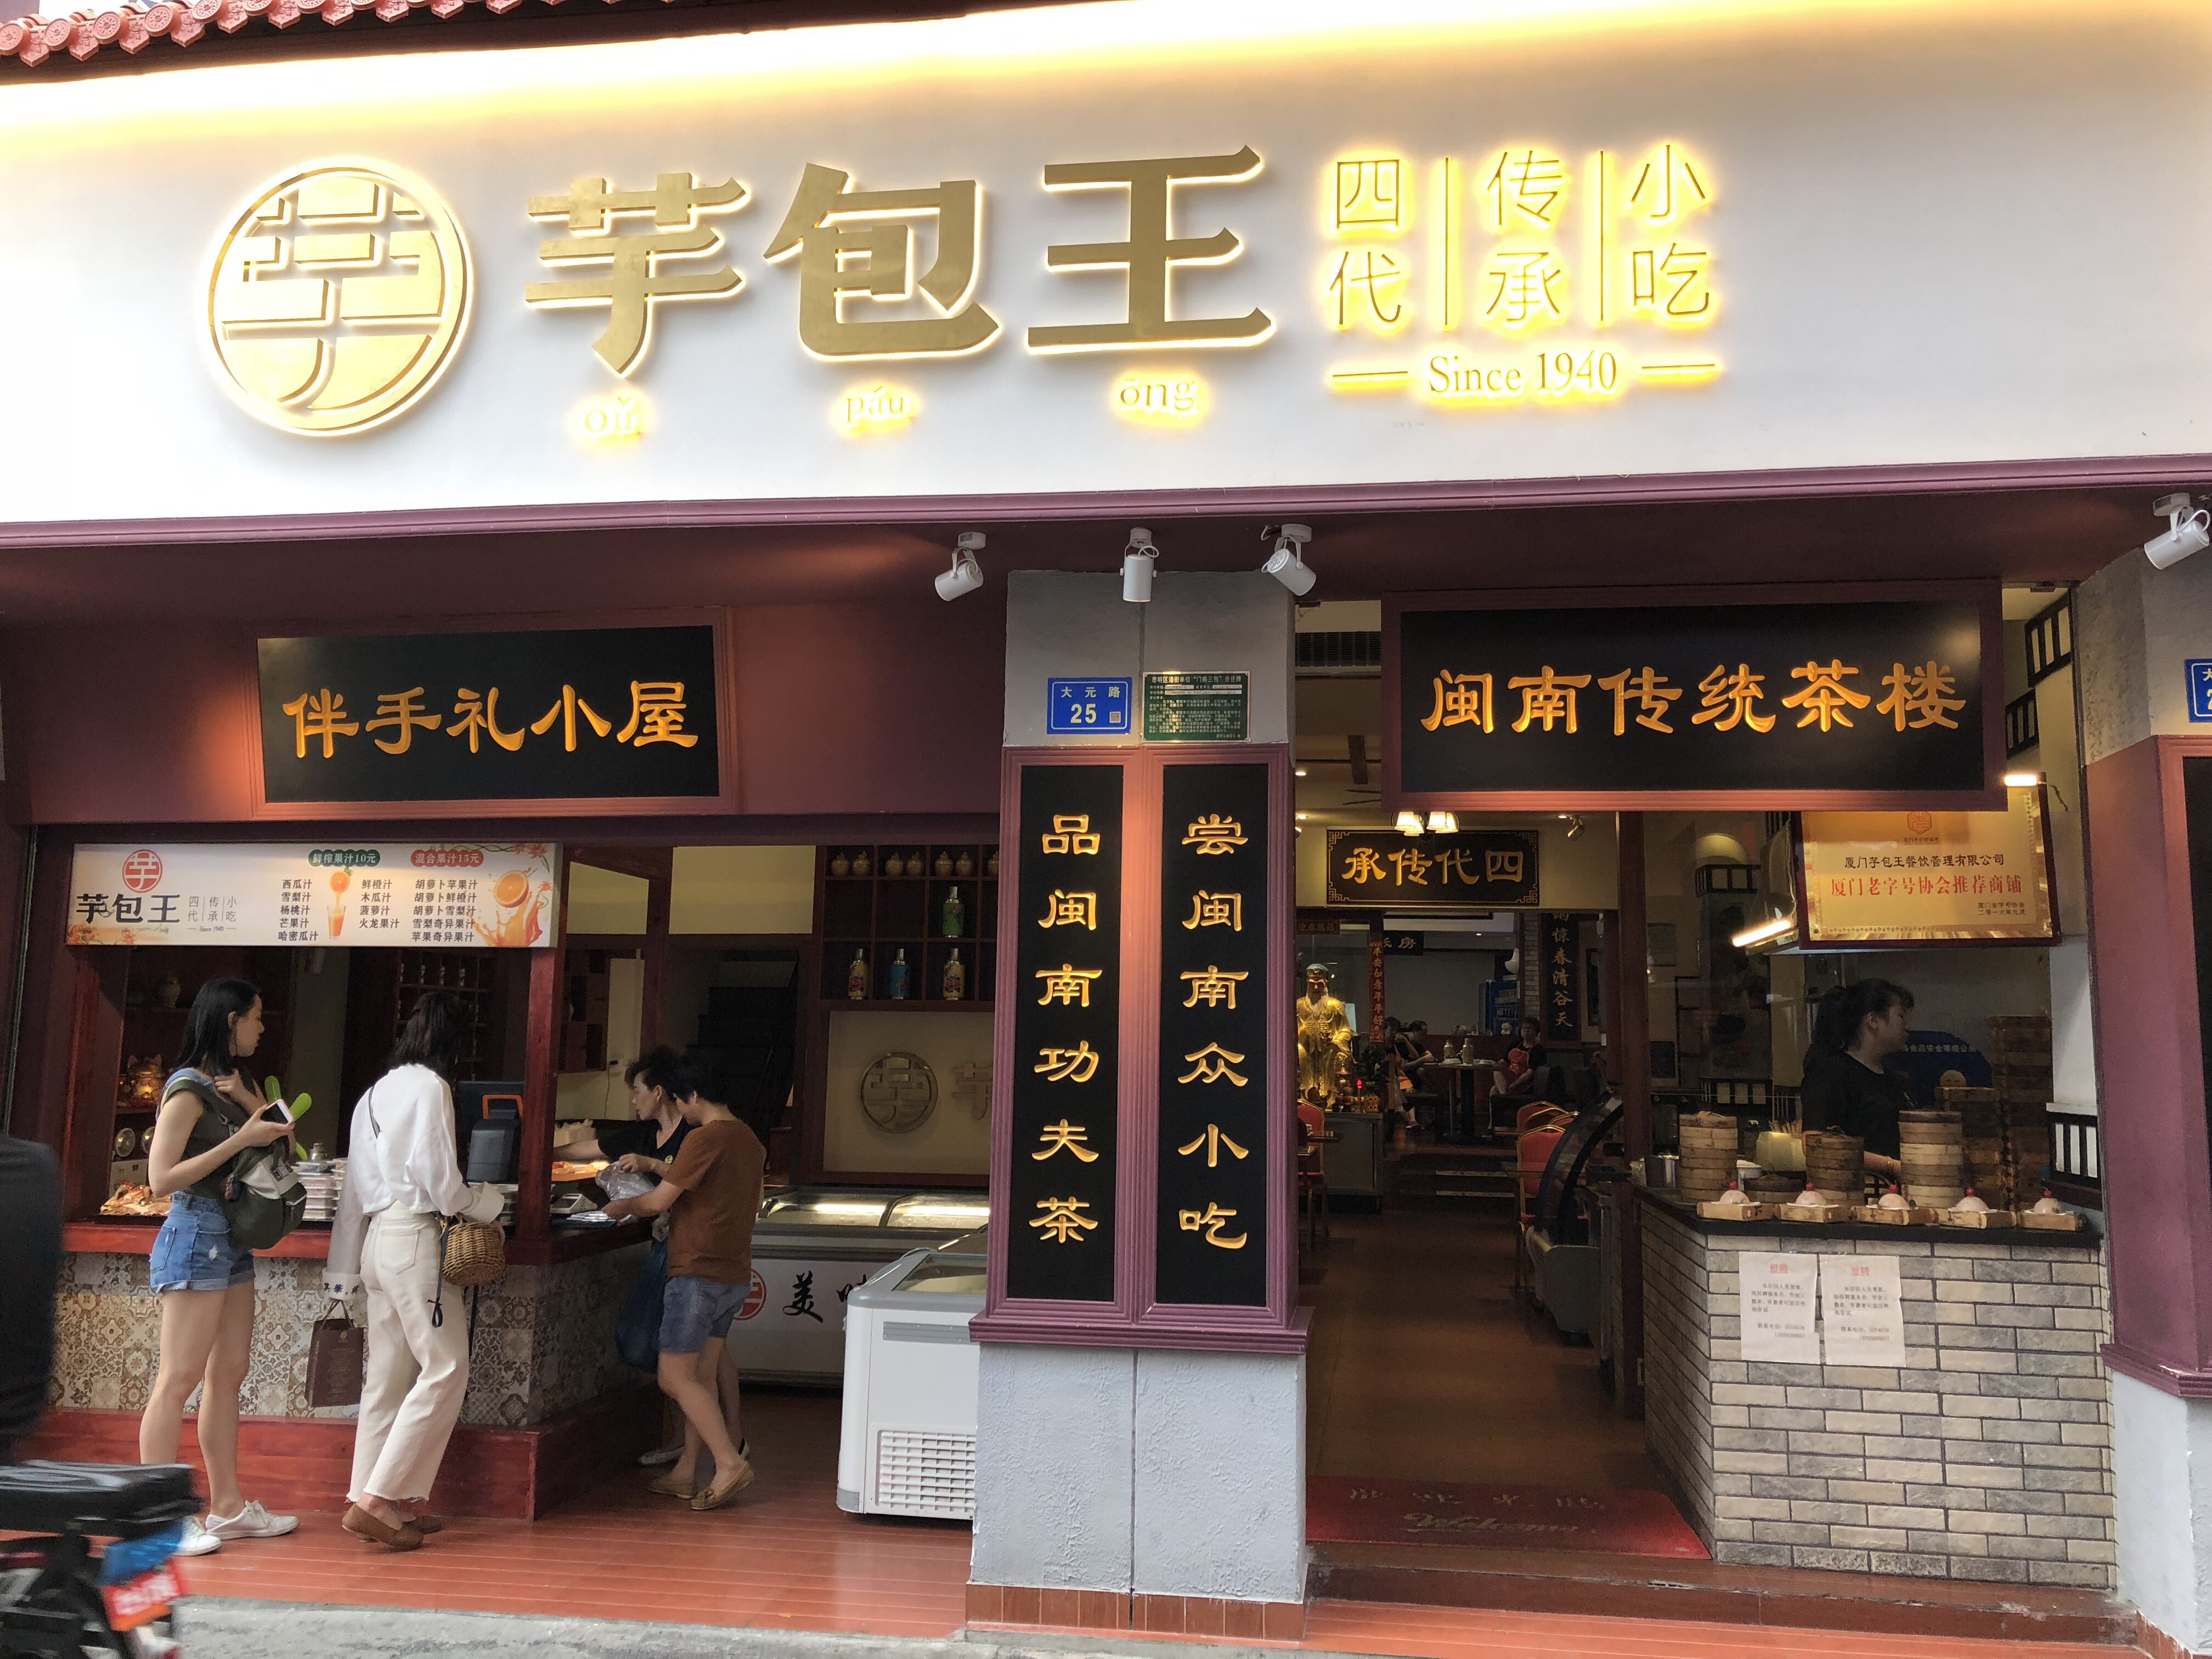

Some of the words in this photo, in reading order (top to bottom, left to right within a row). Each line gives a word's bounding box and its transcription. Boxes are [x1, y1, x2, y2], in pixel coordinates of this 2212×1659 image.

[1632, 144, 1711, 316] 小吃
[1330, 159, 1402, 326] 四代
[1486, 150, 1562, 323] 传承
[525, 144, 1271, 375] 芋包王
[1428, 354, 1521, 393] Since
[1537, 351, 1617, 391] 1940
[1060, 686, 1121, 699] 大元路
[1421, 659, 1967, 736] 闽南传统茶楼
[282, 680, 698, 758] 伴手礼小屋
[1070, 703, 1097, 724] 25
[415, 853, 480, 864] 混合果汁15元
[1844, 853, 2005, 869] 厦门芋包王餐饮管理有限公司
[282, 879, 313, 889] 西瓜汁
[362, 879, 392, 889] 鲜橙汁
[415, 879, 478, 889] 胡萝卜苹果汁
[1831, 874, 2022, 897] 厦门老字号协会推荐商铺
[281, 892, 312, 902] 雪梨汁
[360, 892, 391, 902] 木瓜汁
[414, 892, 477, 903] 胡萝卜鲜橙汁
[76, 893, 180, 924] 芋包王
[280, 905, 311, 916] 杨桃汁
[359, 905, 390, 916] 菠萝汁
[413, 905, 476, 916] 胡萝卜雪梨汁
[279, 918, 309, 928] 芒果汁
[359, 918, 400, 929] 火龙果汁
[412, 918, 476, 929] 雪梨奇异果汁
[278, 931, 319, 941] 哈密瓜汁
[411, 931, 475, 943] 苹果奇异果汁
[1029, 814, 1103, 1244] 品闽南功夫茶
[1178, 814, 1249, 1249] 尝闽南众小吃
